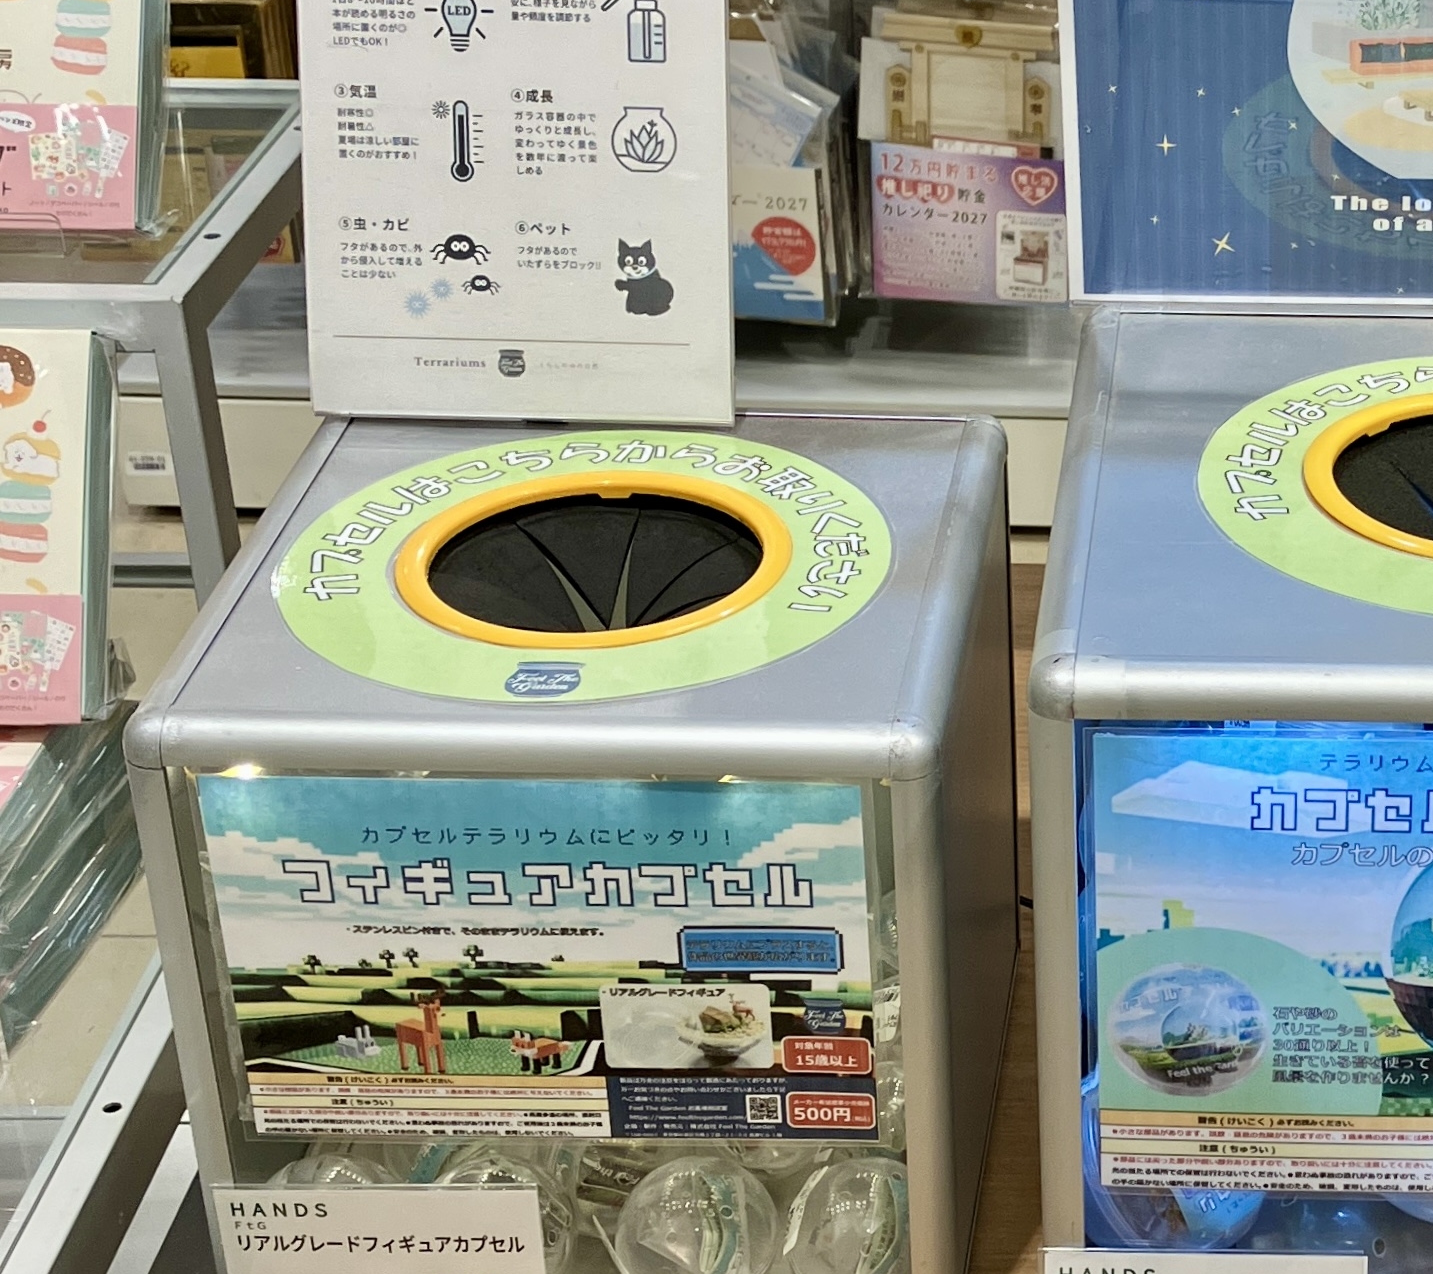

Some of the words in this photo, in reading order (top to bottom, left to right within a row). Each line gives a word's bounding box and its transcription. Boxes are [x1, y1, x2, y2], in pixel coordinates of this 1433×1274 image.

[448, 6, 471, 16] LED
[764, 197, 807, 211] 2027
[1332, 194, 1390, 213] The
[882, 203, 988, 225] カレンダー2027
[1372, 215, 1406, 232] of
[414, 355, 486, 369] Terrariums
[304, 439, 870, 613] カプセルはこちらからお取りください
[361, 825, 733, 848] カプセルテラリウムにピッタリ！
[281, 857, 814, 909] フィギュアカプセル
[796, 1055, 858, 1067] 15歳以上
[794, 1107, 850, 1122] 500円
[230, 1202, 328, 1218] HANDS
[238, 1235, 525, 1254] リアルグレードフィギュアカプセル
